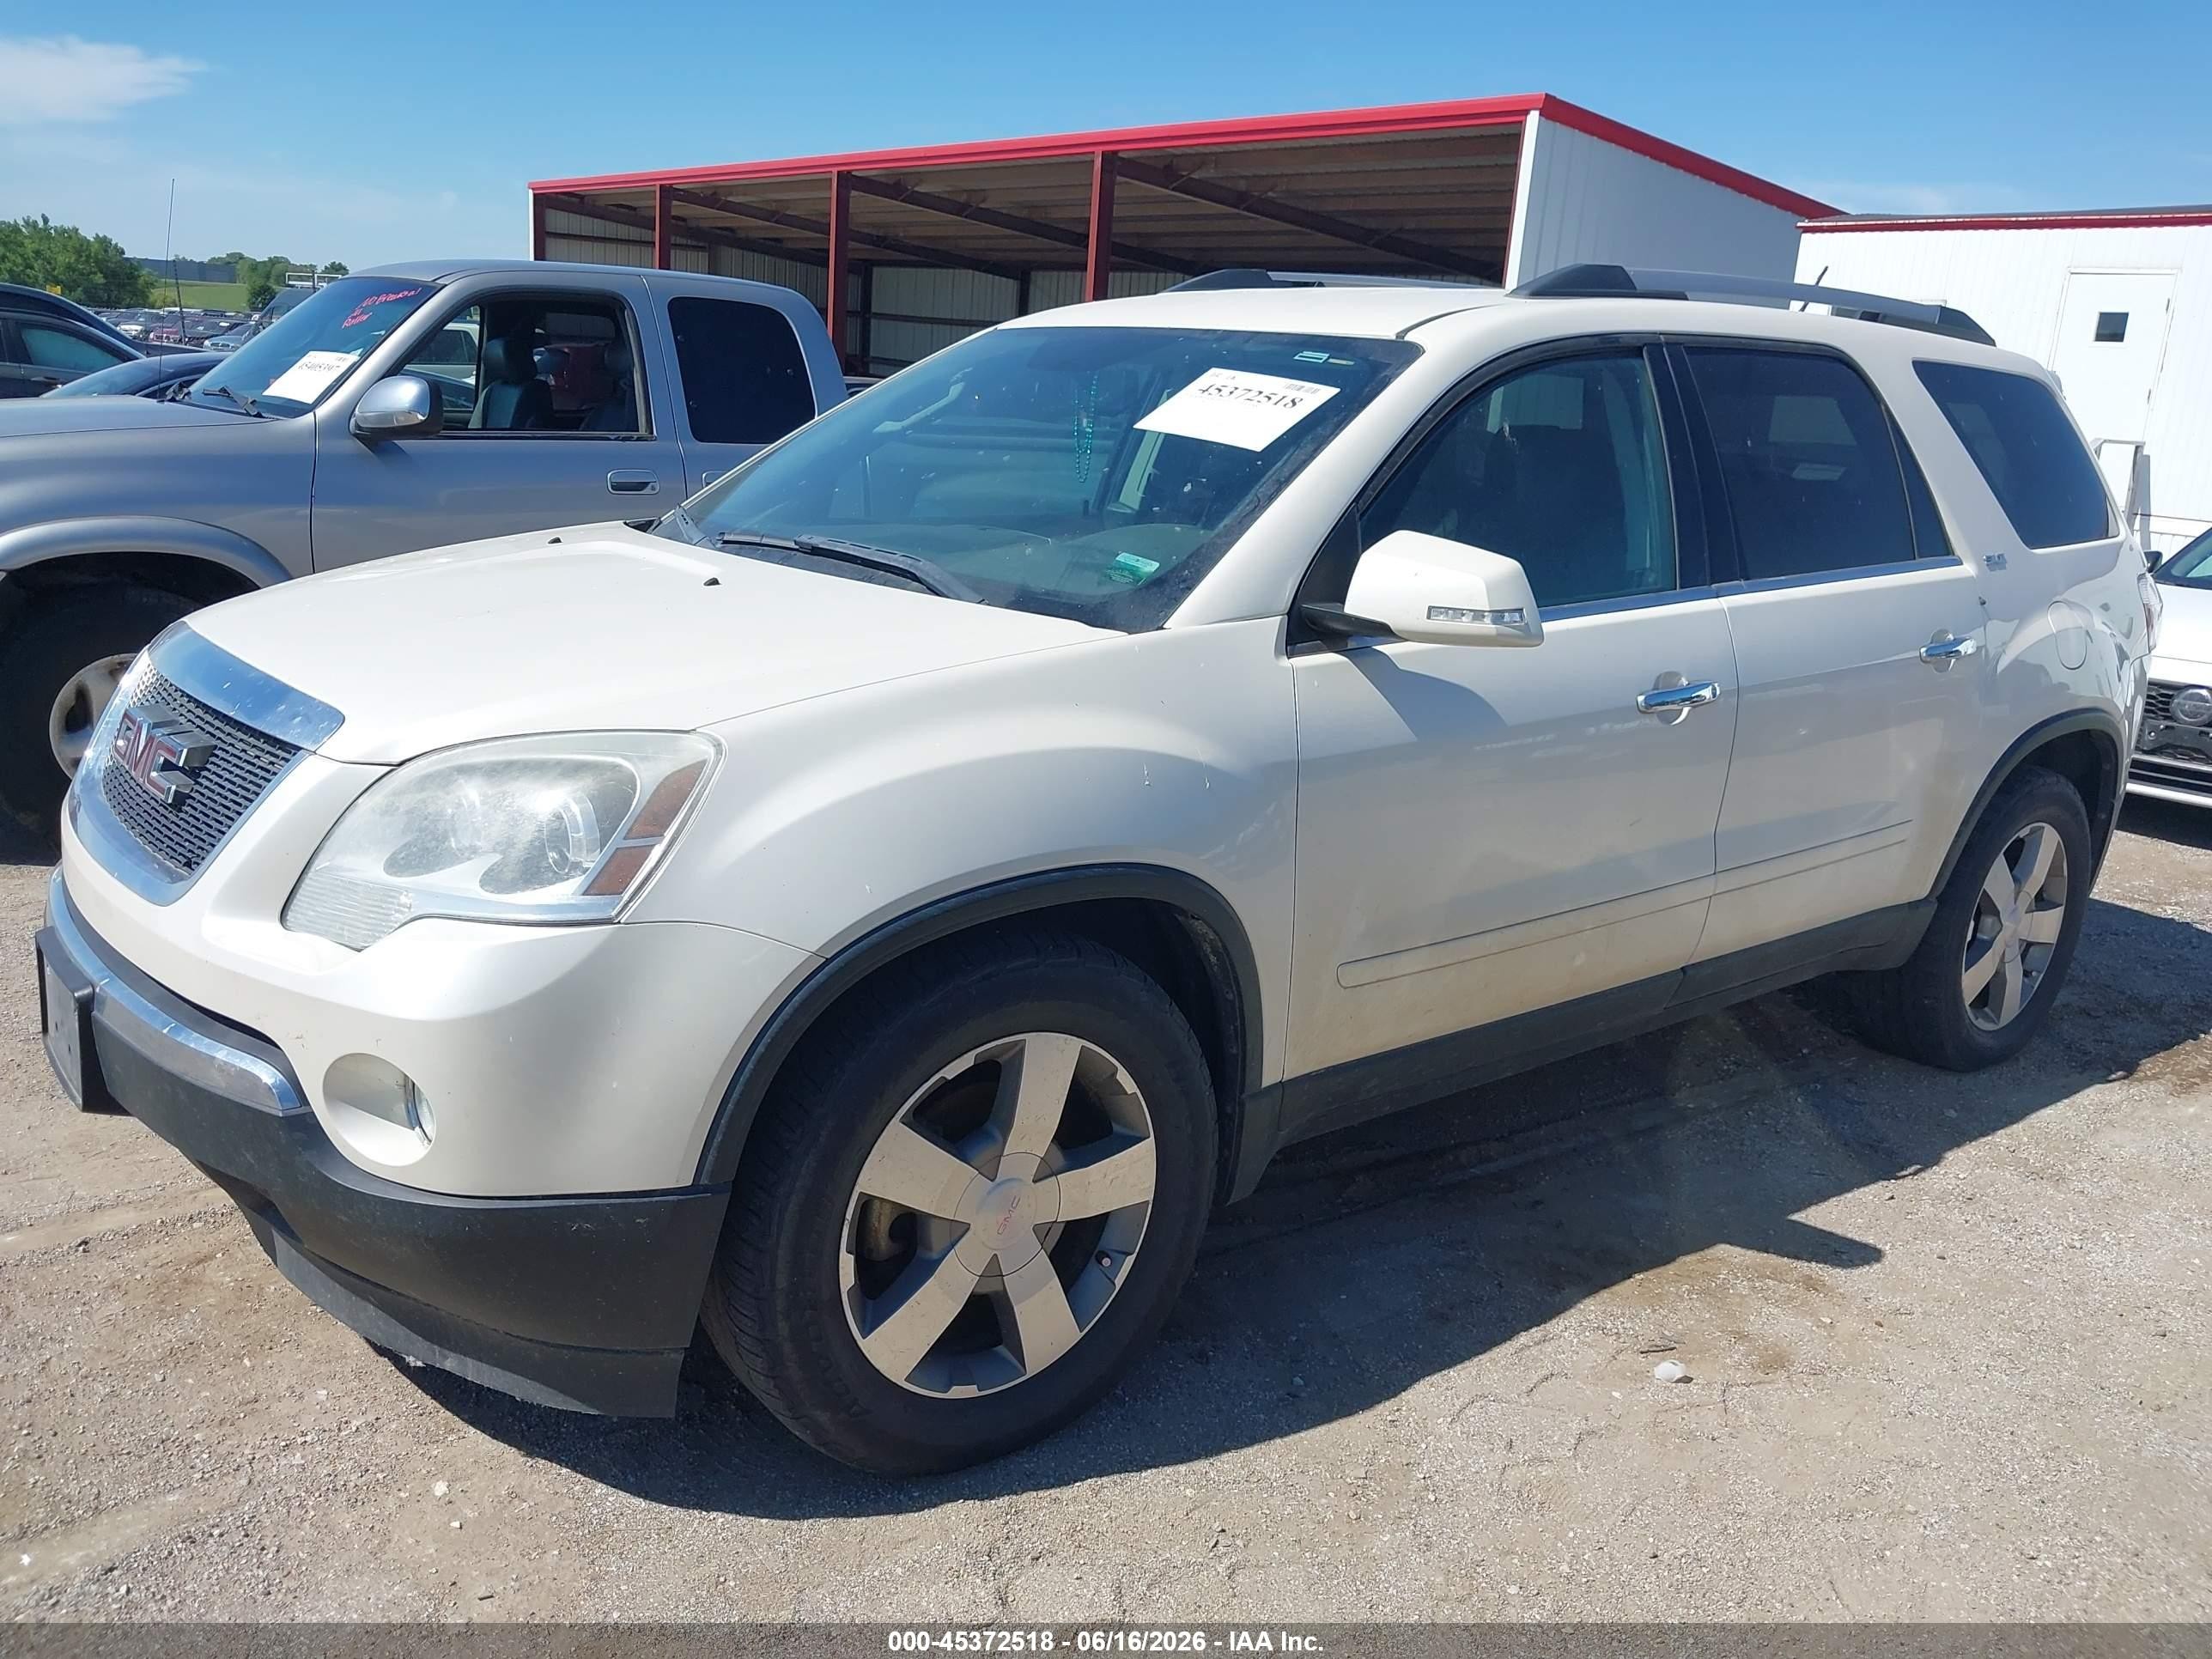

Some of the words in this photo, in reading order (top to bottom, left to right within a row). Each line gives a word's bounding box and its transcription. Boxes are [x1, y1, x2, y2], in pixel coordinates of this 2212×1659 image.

[1198, 383, 1304, 409] 45372518
[114, 708, 191, 804] GMC
[997, 1195, 1021, 1236] GMC
